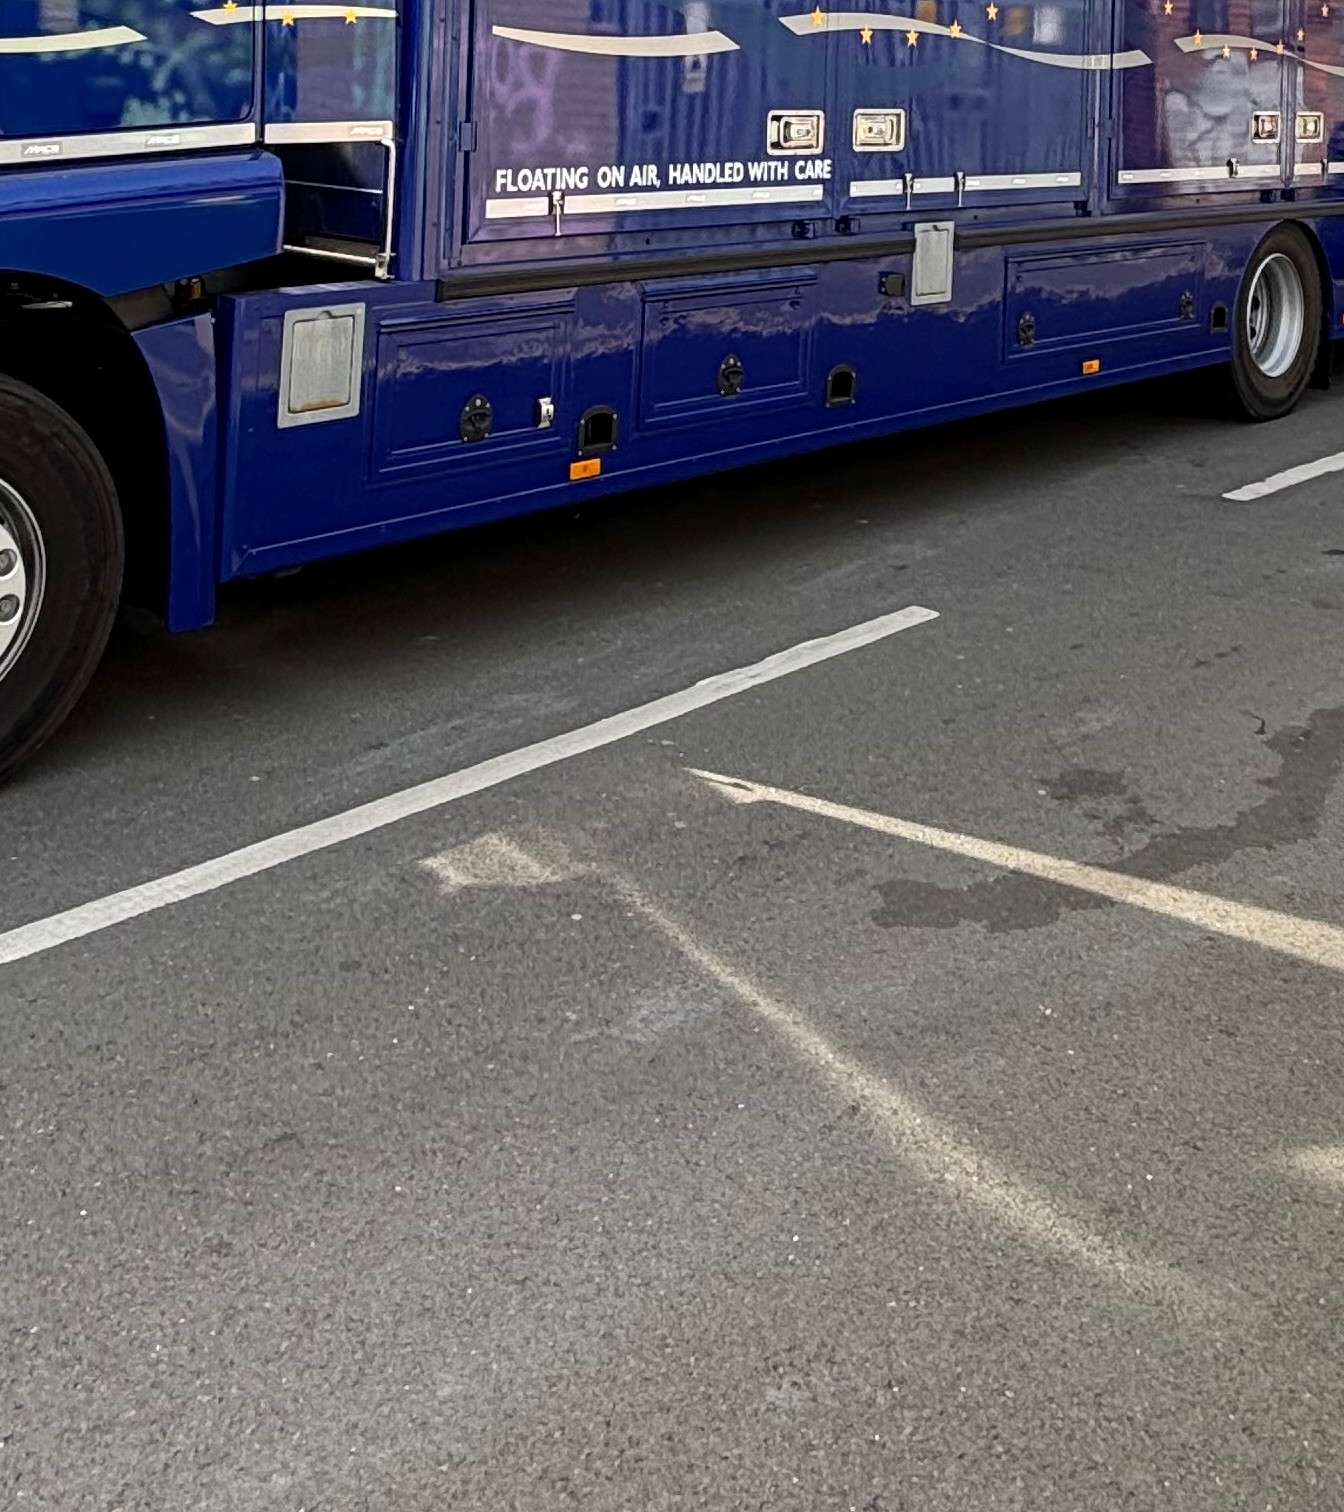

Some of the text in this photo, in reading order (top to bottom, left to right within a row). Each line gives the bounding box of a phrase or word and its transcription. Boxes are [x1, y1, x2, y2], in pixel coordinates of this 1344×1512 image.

[495, 158, 832, 193] FLOATING ON AIR, HANDLED WITH CARE
